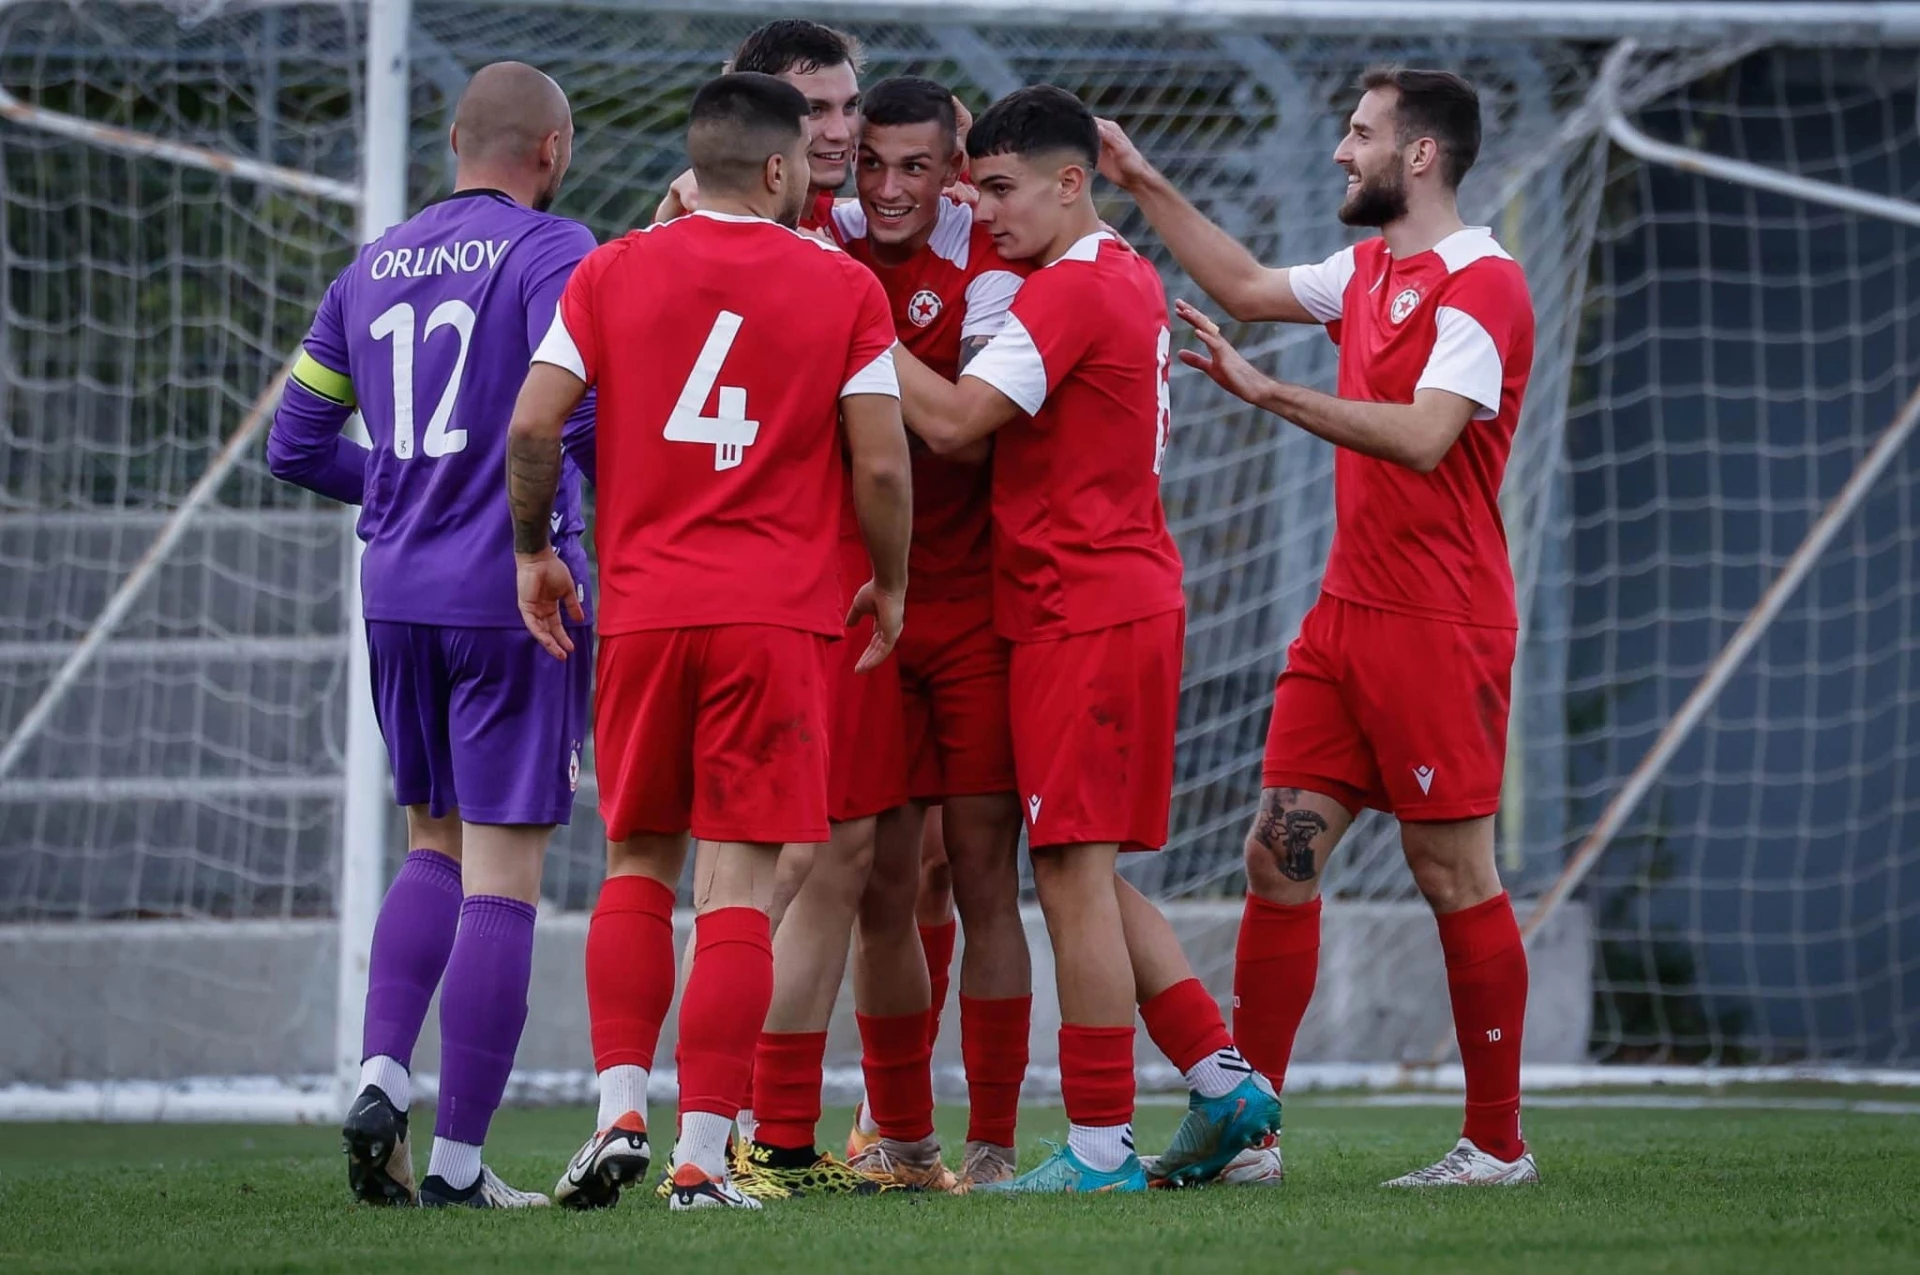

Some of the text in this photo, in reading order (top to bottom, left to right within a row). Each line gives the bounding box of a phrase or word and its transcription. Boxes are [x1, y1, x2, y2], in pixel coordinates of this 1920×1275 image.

[371, 240, 509, 280] ORLINOV
[370, 300, 476, 459] 12
[663, 310, 760, 471] 4
[1486, 1028, 1502, 1042] 10
